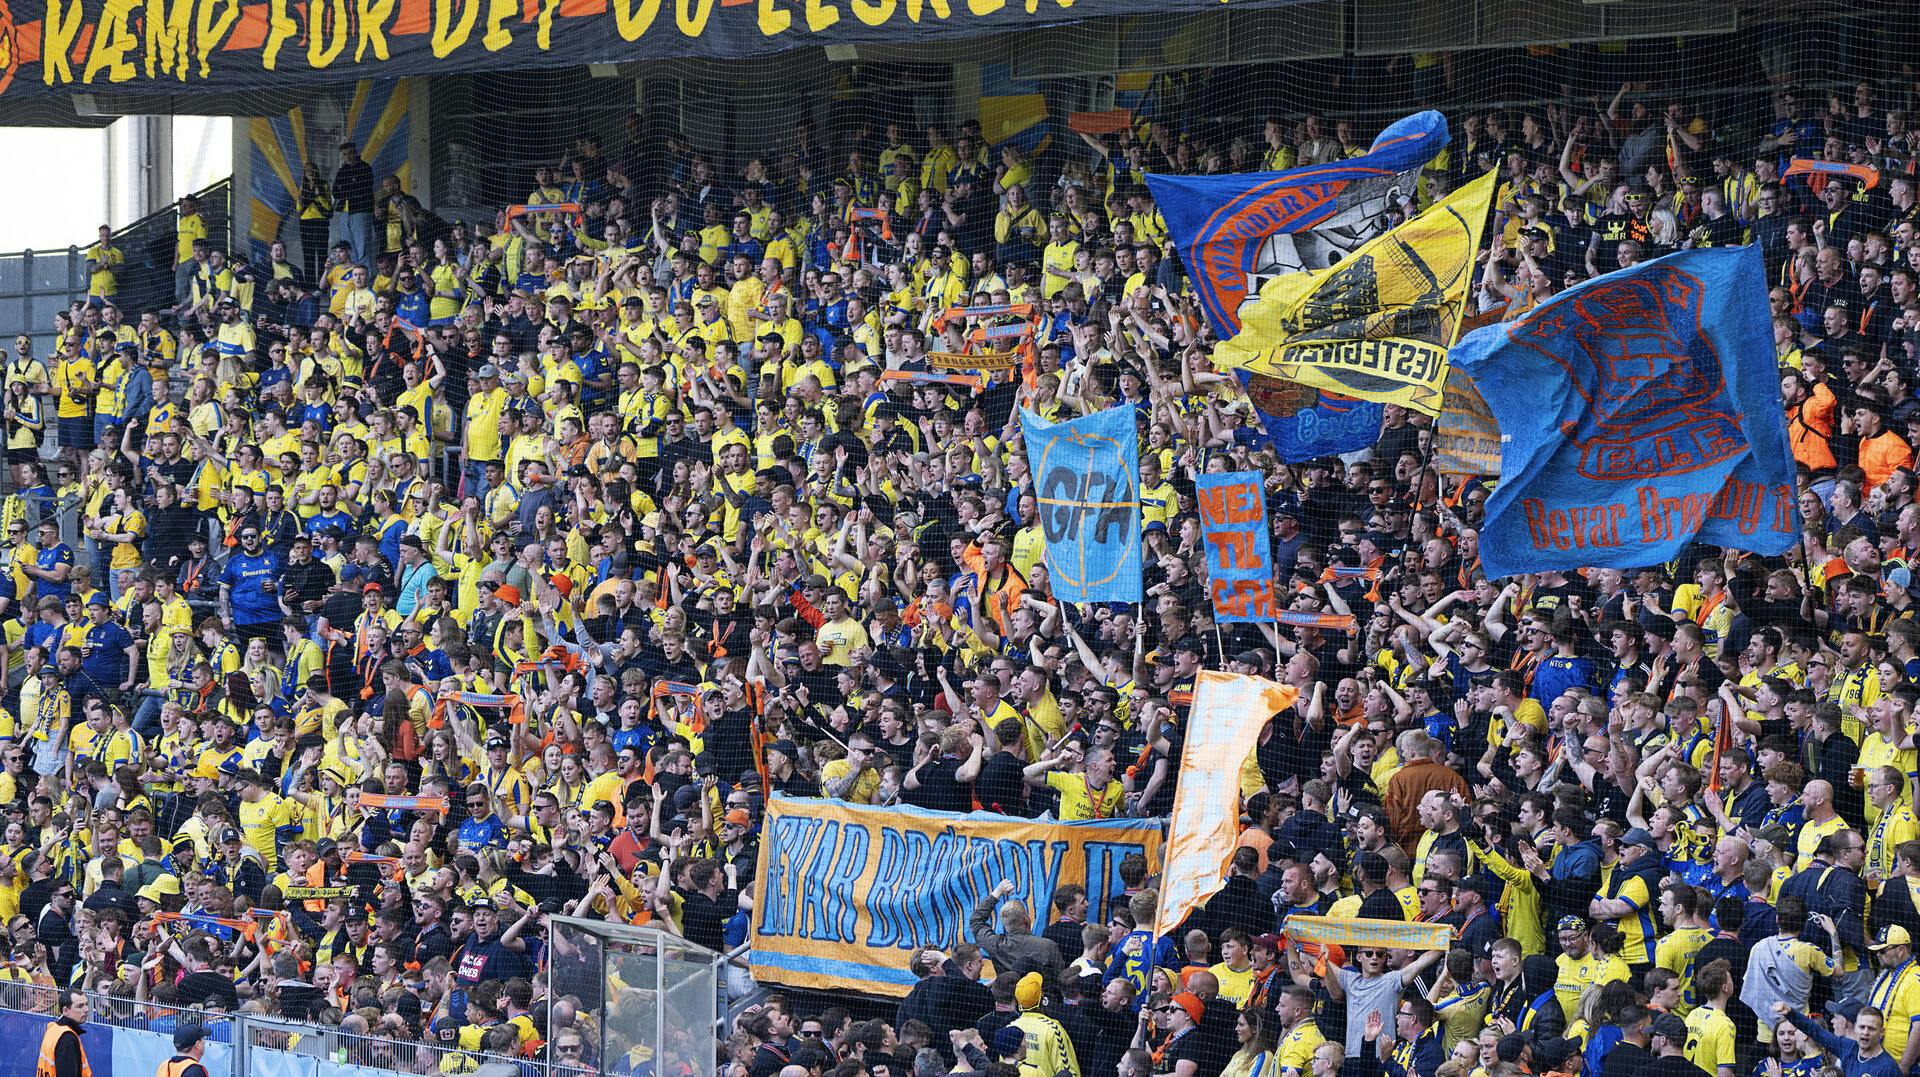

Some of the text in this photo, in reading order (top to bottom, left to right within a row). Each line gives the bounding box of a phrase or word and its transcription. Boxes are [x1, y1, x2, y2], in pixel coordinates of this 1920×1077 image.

[43, 0, 239, 86] KÆMP
[1040, 466, 1134, 546] GFH
[1198, 483, 1263, 527] NEJ
[1522, 497, 1628, 551] Bevar
[1211, 578, 1276, 617] GFH
